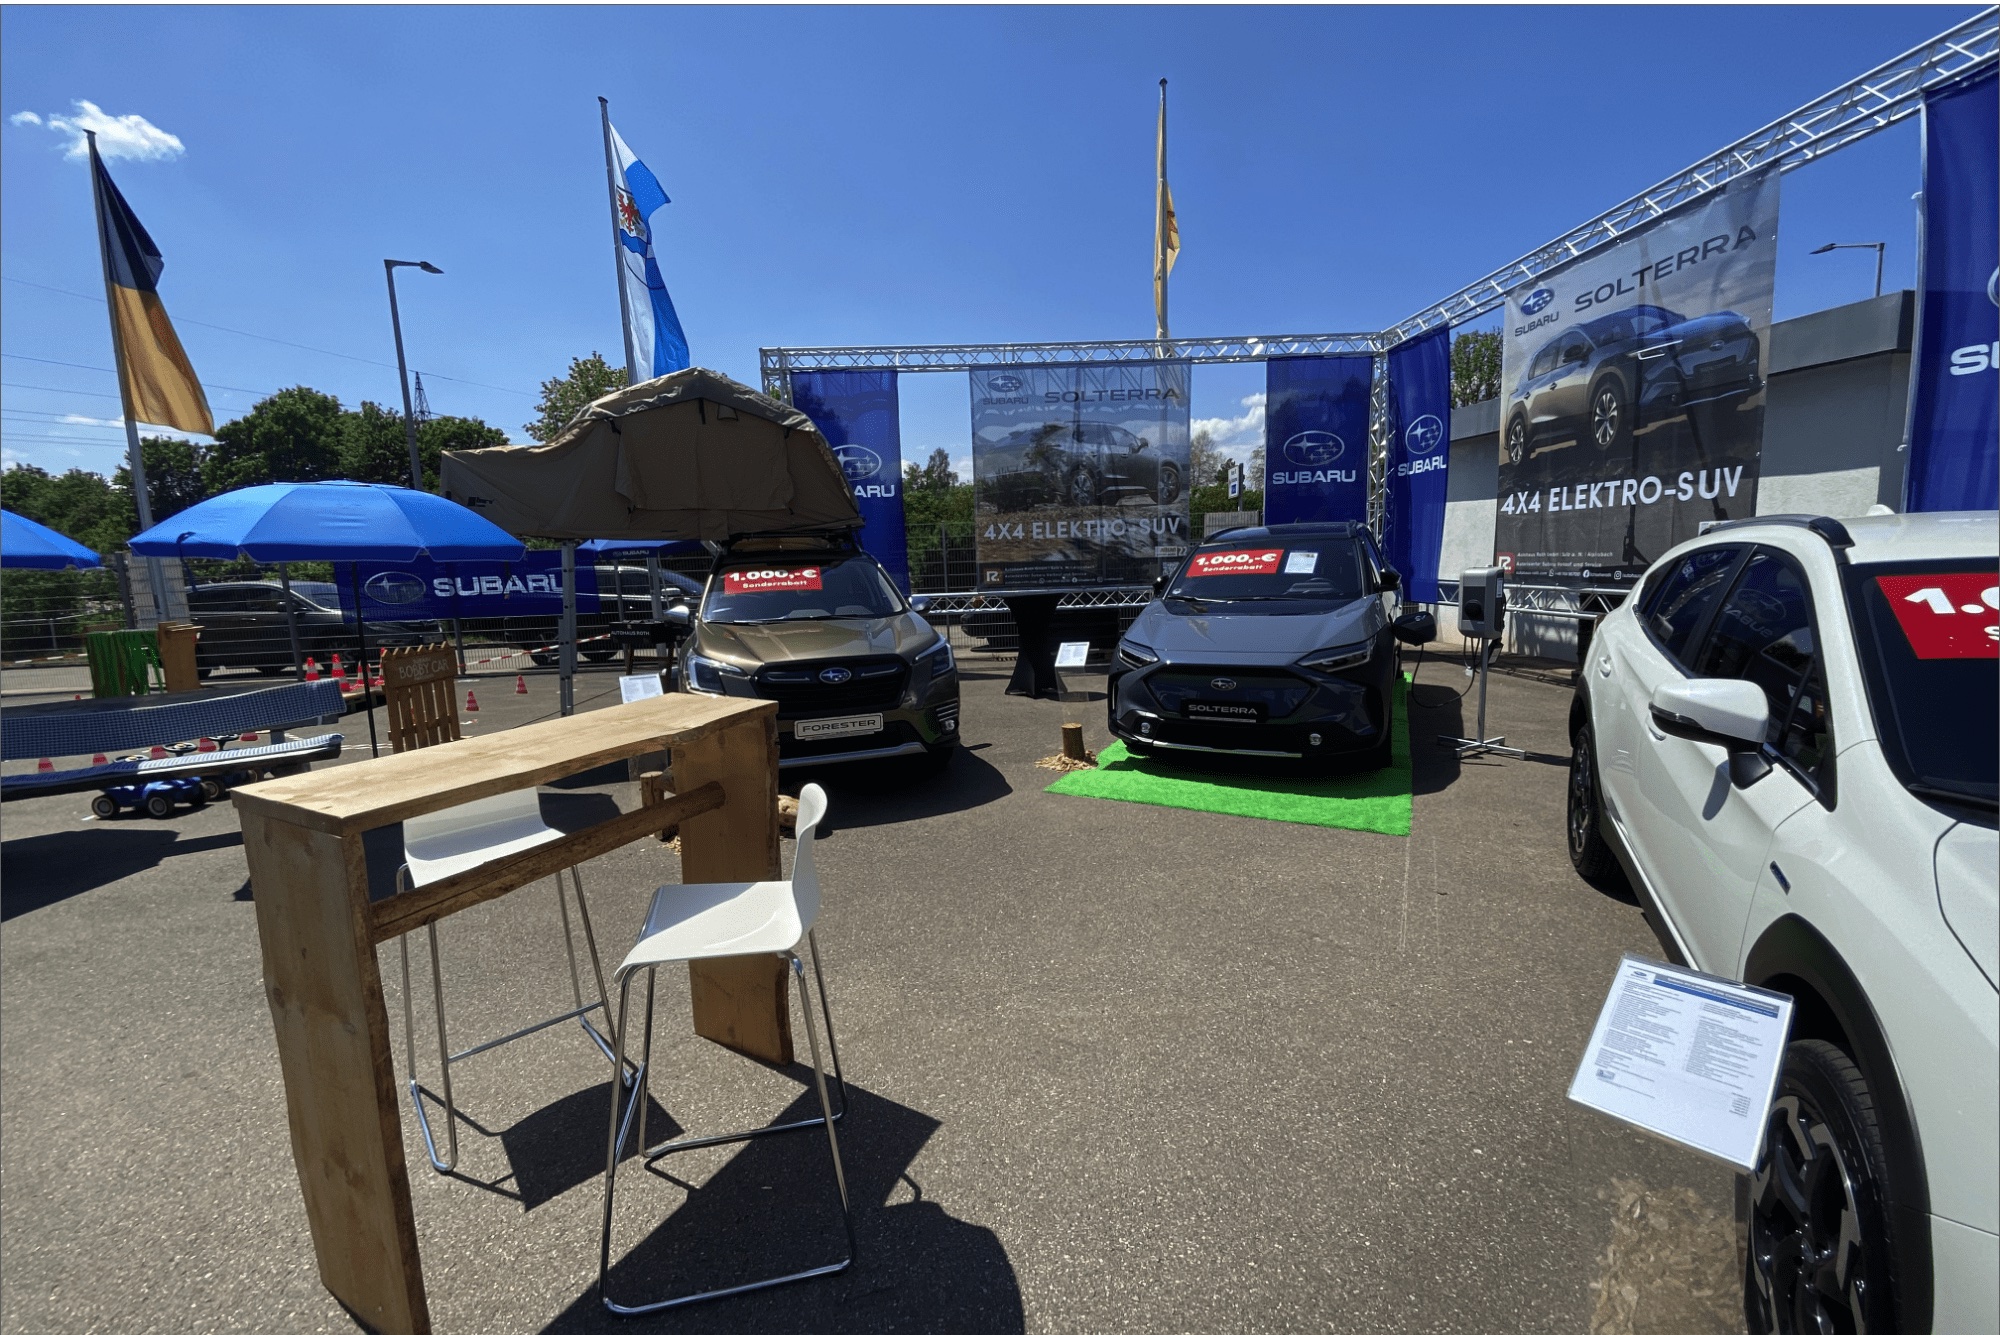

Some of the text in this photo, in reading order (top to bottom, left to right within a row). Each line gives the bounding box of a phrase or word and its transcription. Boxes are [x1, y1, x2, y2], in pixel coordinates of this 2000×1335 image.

[1575, 225, 1756, 313] SOLTERRA
[1514, 311, 1559, 337] SUBARU
[1950, 341, 1999, 375] S
[983, 397, 1029, 405] SUBARU
[1044, 388, 1180, 404] SOLTERRA
[1272, 470, 1356, 484] SUBARU
[854, 484, 895, 498] ARU
[1500, 465, 1743, 515] 4X4 ELEKTRO-SUV
[984, 517, 1180, 540] 4X4 ELEKTRO-SUV
[1196, 553, 1277, 566] 1.000,-€
[1203, 564, 1263, 572] Sonderrabatt
[729, 569, 817, 582] 1.000,-€
[743, 580, 807, 588] Sonderrabatt
[399, 661, 431, 680] BOBBY
[431, 659, 450, 673] CAR
[1188, 704, 1258, 715] SOLTERRA
[802, 719, 876, 733] FORESTER
